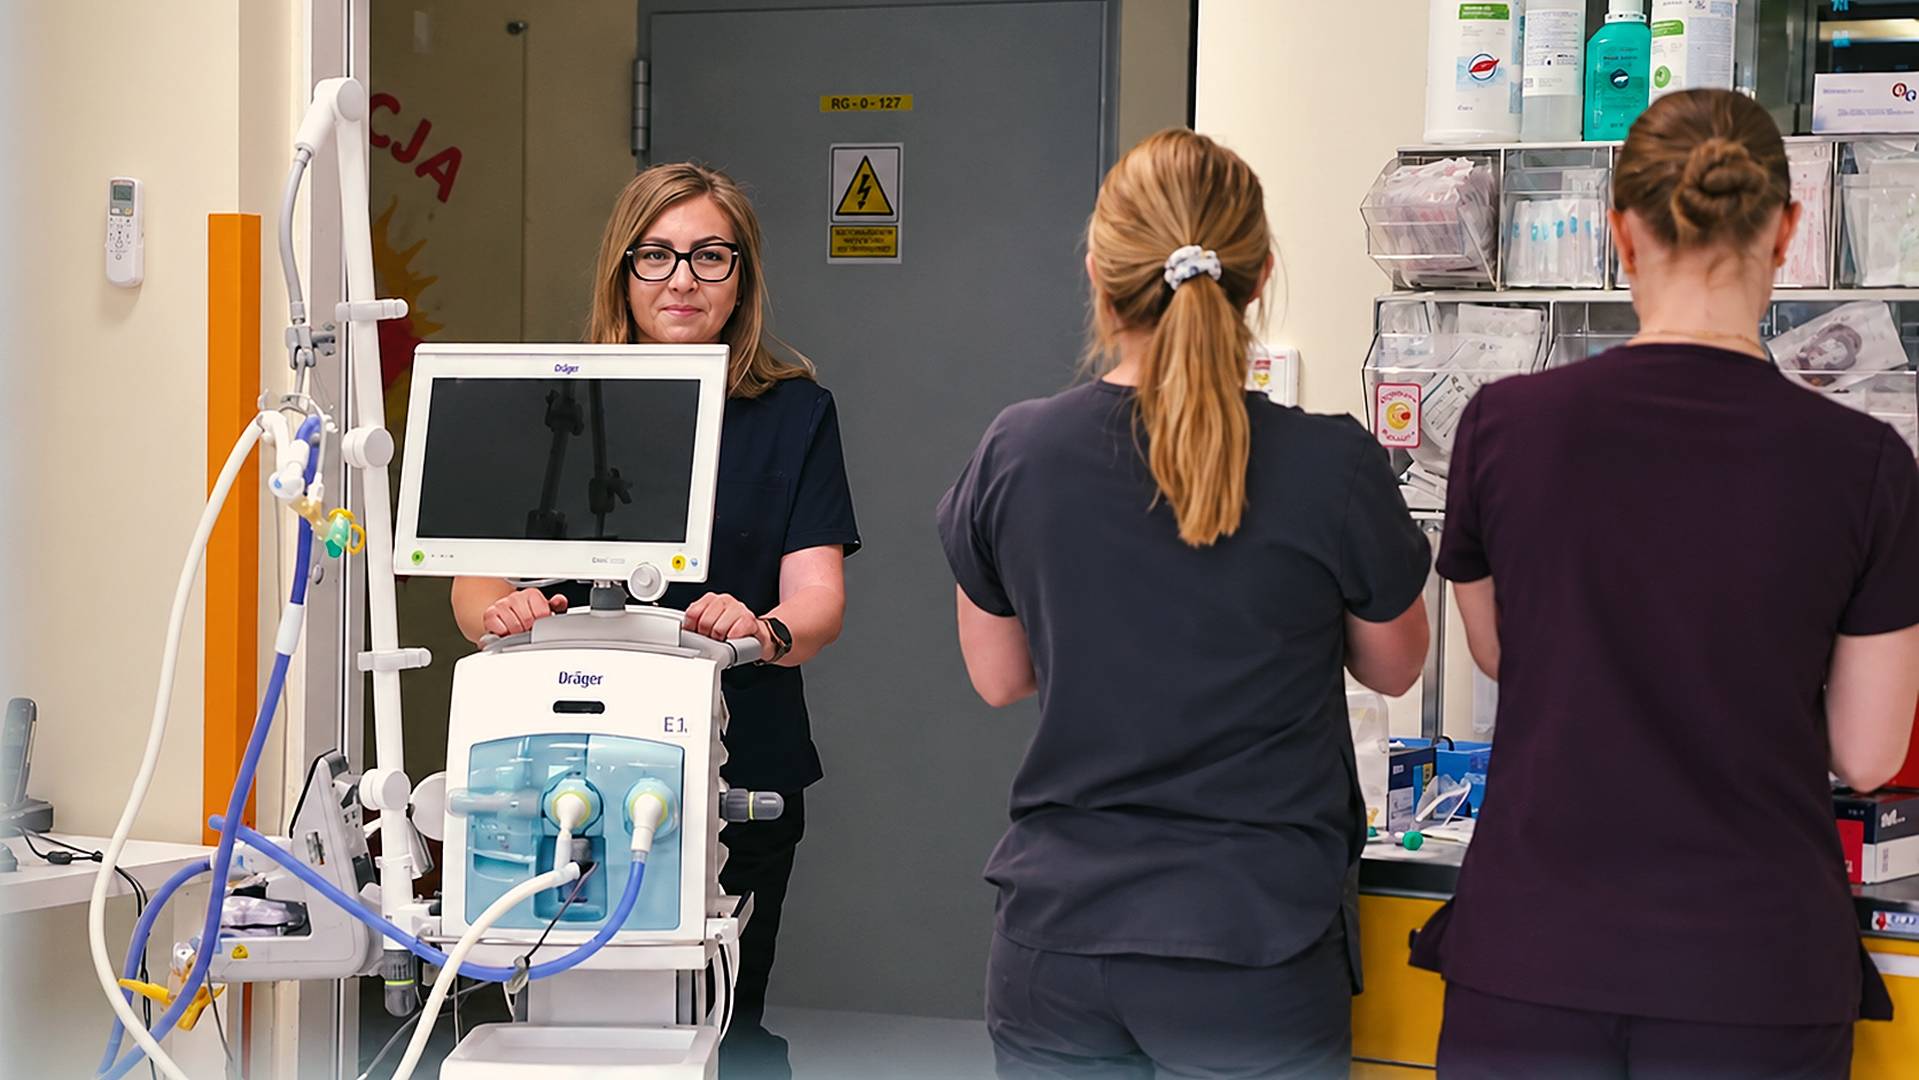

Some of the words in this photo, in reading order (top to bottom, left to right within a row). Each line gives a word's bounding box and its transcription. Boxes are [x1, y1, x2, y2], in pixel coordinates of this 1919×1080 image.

[831, 97, 850, 110] RG
[879, 97, 902, 109] 127
[558, 670, 604, 688] Dräger
